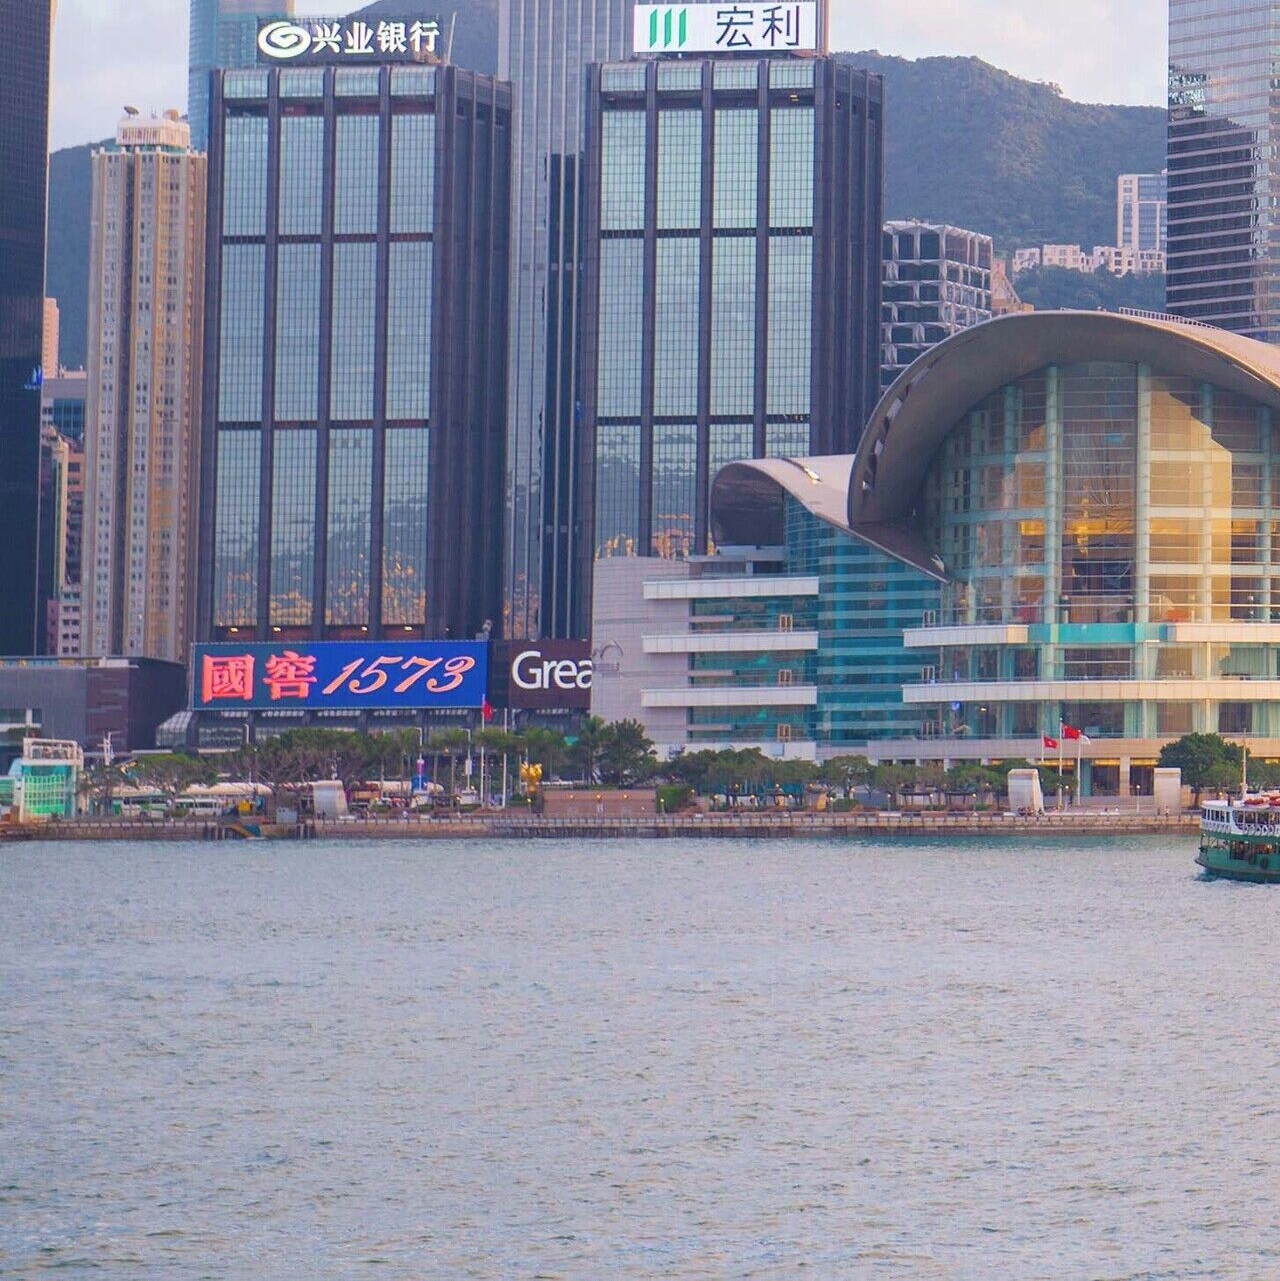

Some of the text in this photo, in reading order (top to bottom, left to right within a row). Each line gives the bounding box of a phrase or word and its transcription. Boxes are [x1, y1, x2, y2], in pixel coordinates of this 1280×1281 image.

[312, 21, 440, 54] 兴业银行
[716, 6, 799, 47] 宏利
[322, 654, 475, 696] 1573
